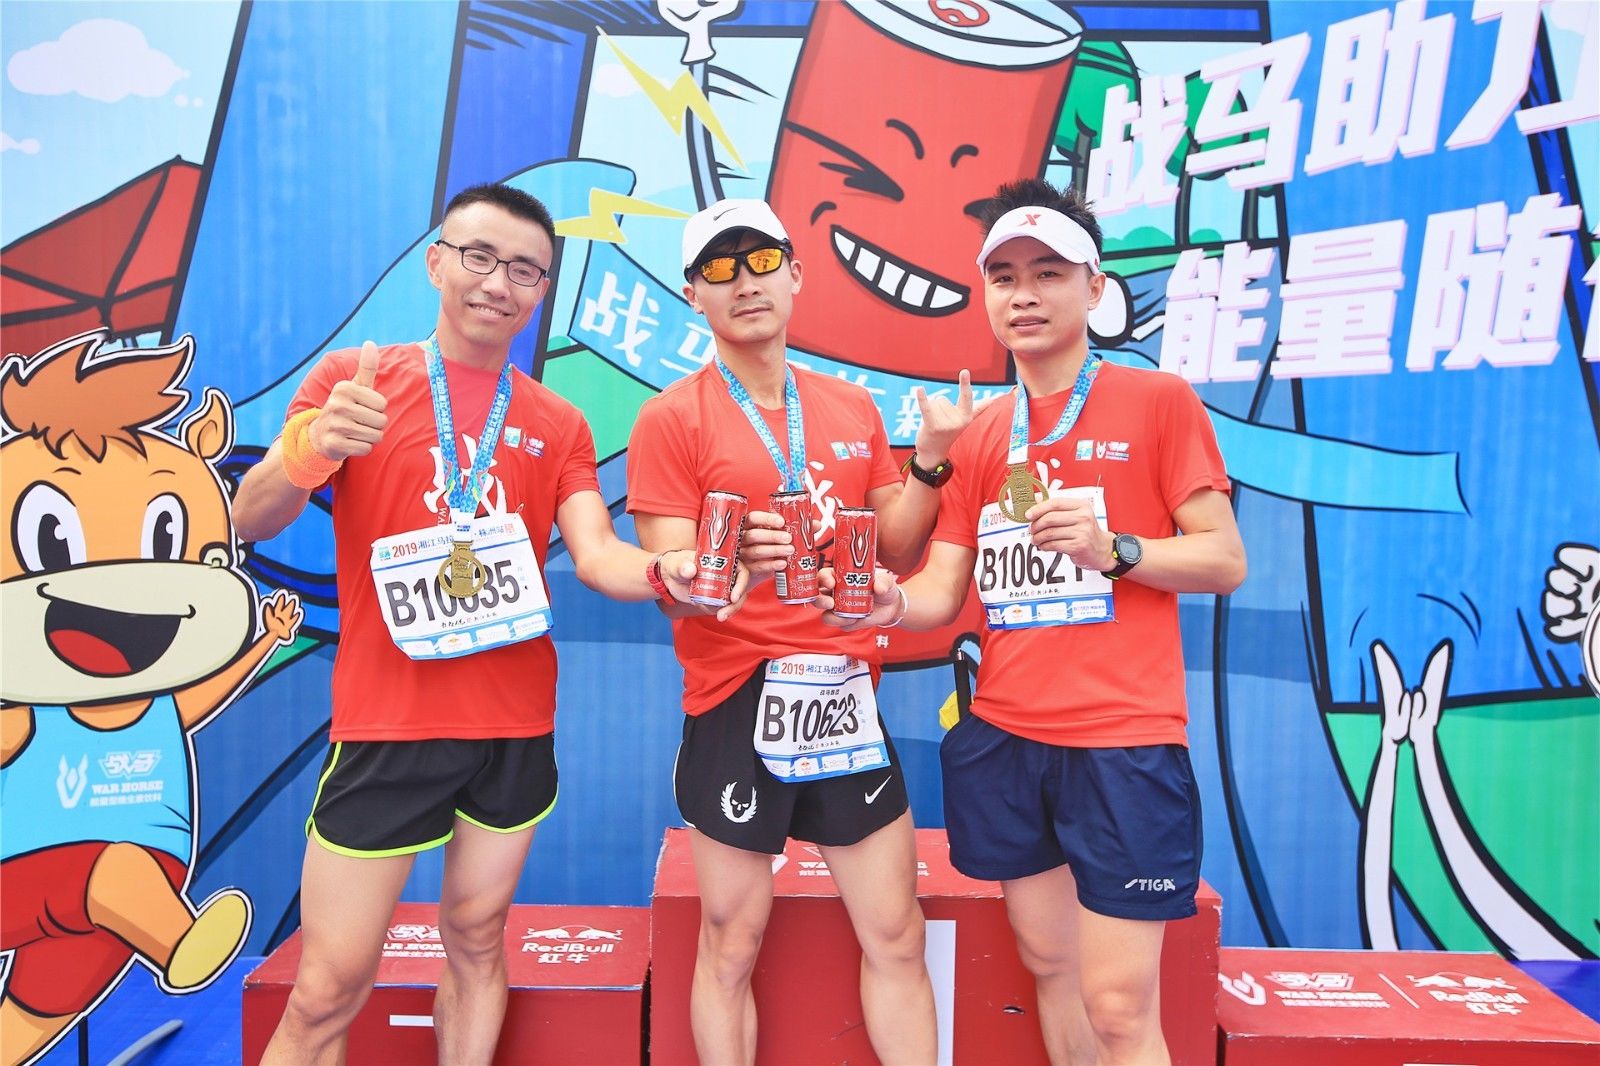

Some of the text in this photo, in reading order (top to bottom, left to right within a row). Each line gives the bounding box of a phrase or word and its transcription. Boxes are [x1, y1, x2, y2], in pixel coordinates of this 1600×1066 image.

[762, 693, 859, 743] B10623
[92, 780, 164, 795] WAR HORSE
[521, 942, 614, 953] RedBull
[537, 953, 590, 964] 红牛
